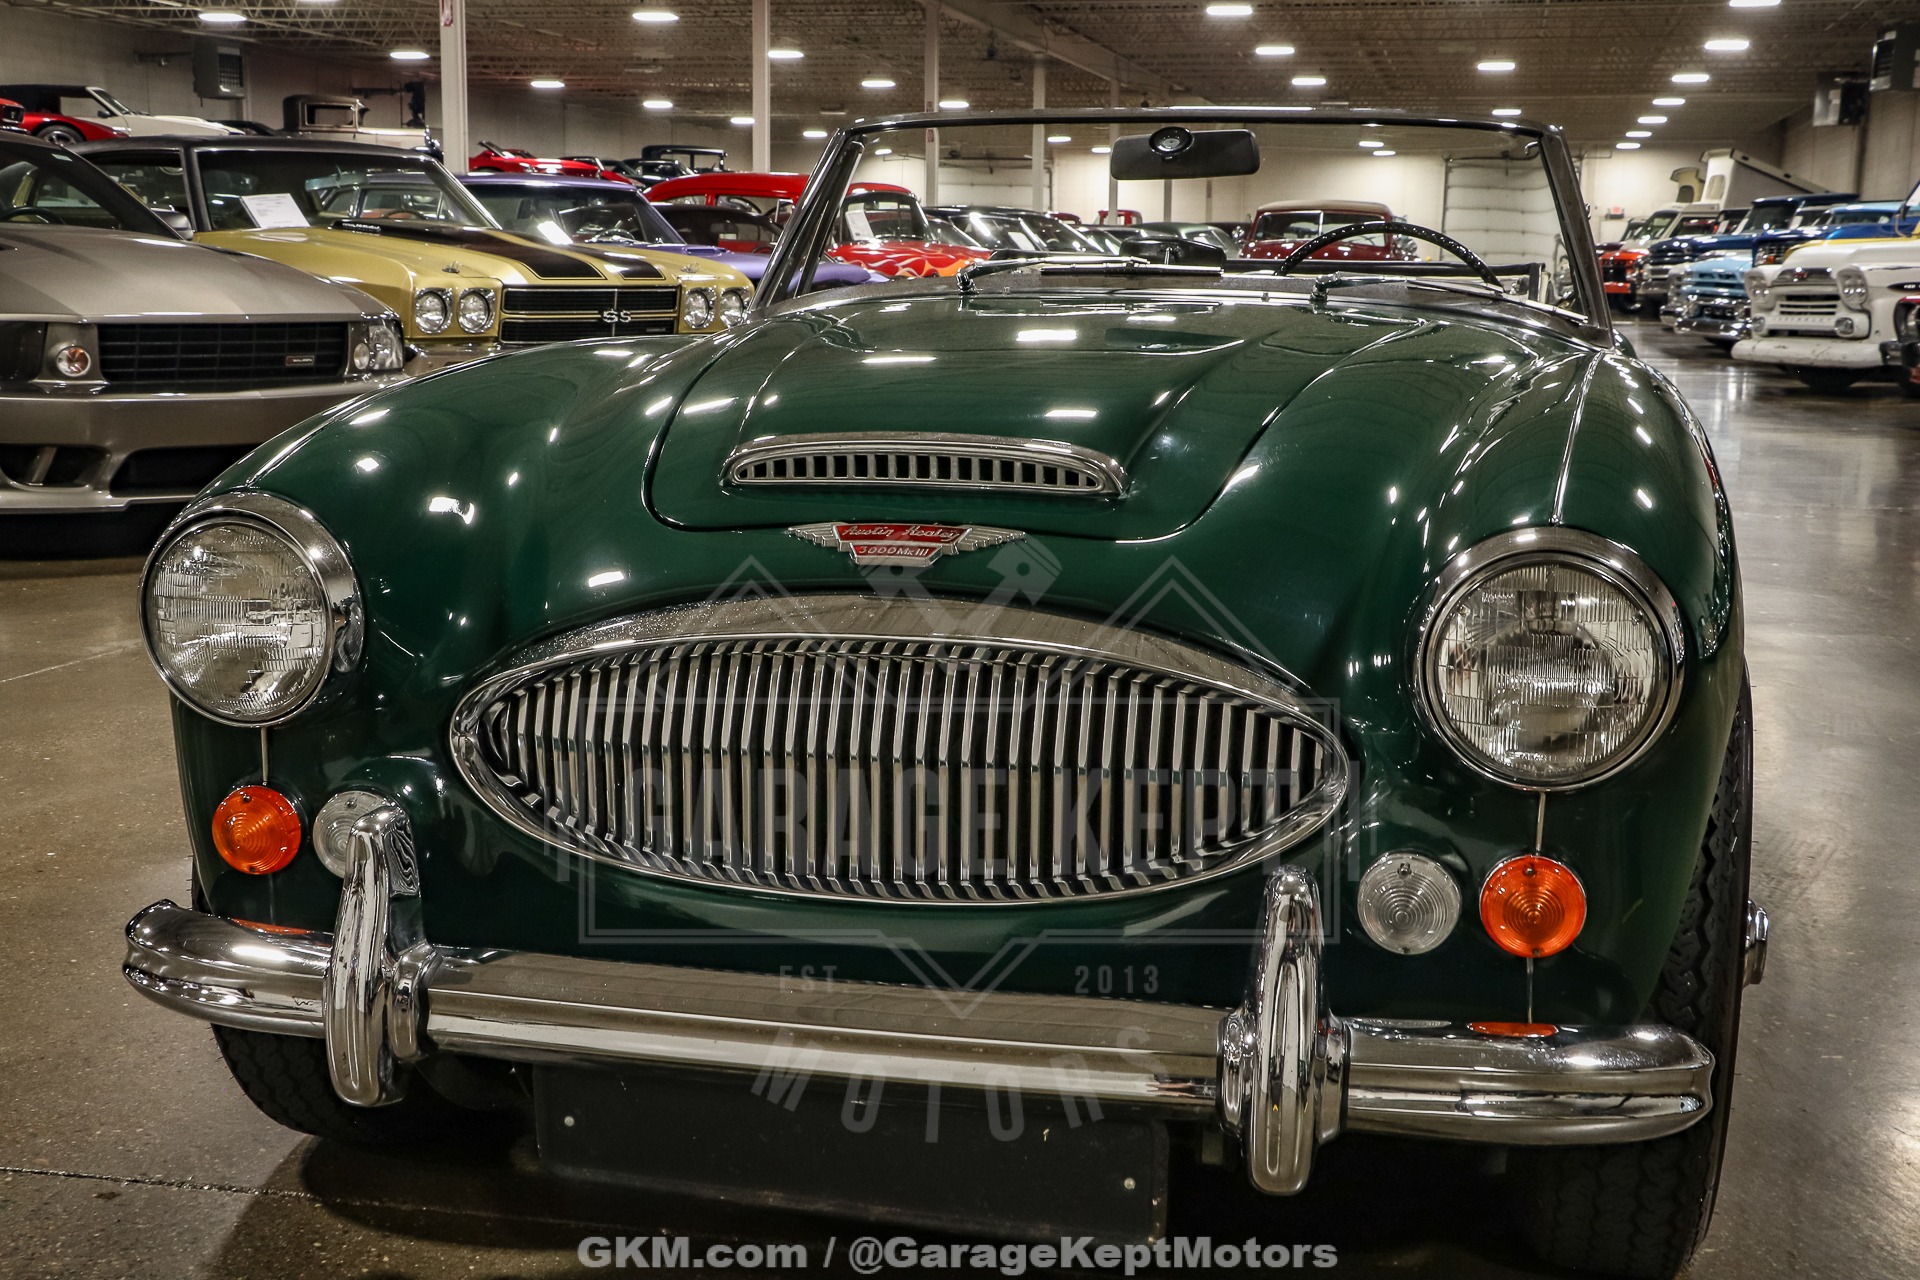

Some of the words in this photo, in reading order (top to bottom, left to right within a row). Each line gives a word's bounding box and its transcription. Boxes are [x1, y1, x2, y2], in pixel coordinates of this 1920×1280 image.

[602, 309, 631, 323] SS
[843, 526, 894, 537] Austin
[903, 526, 959, 541] Healey
